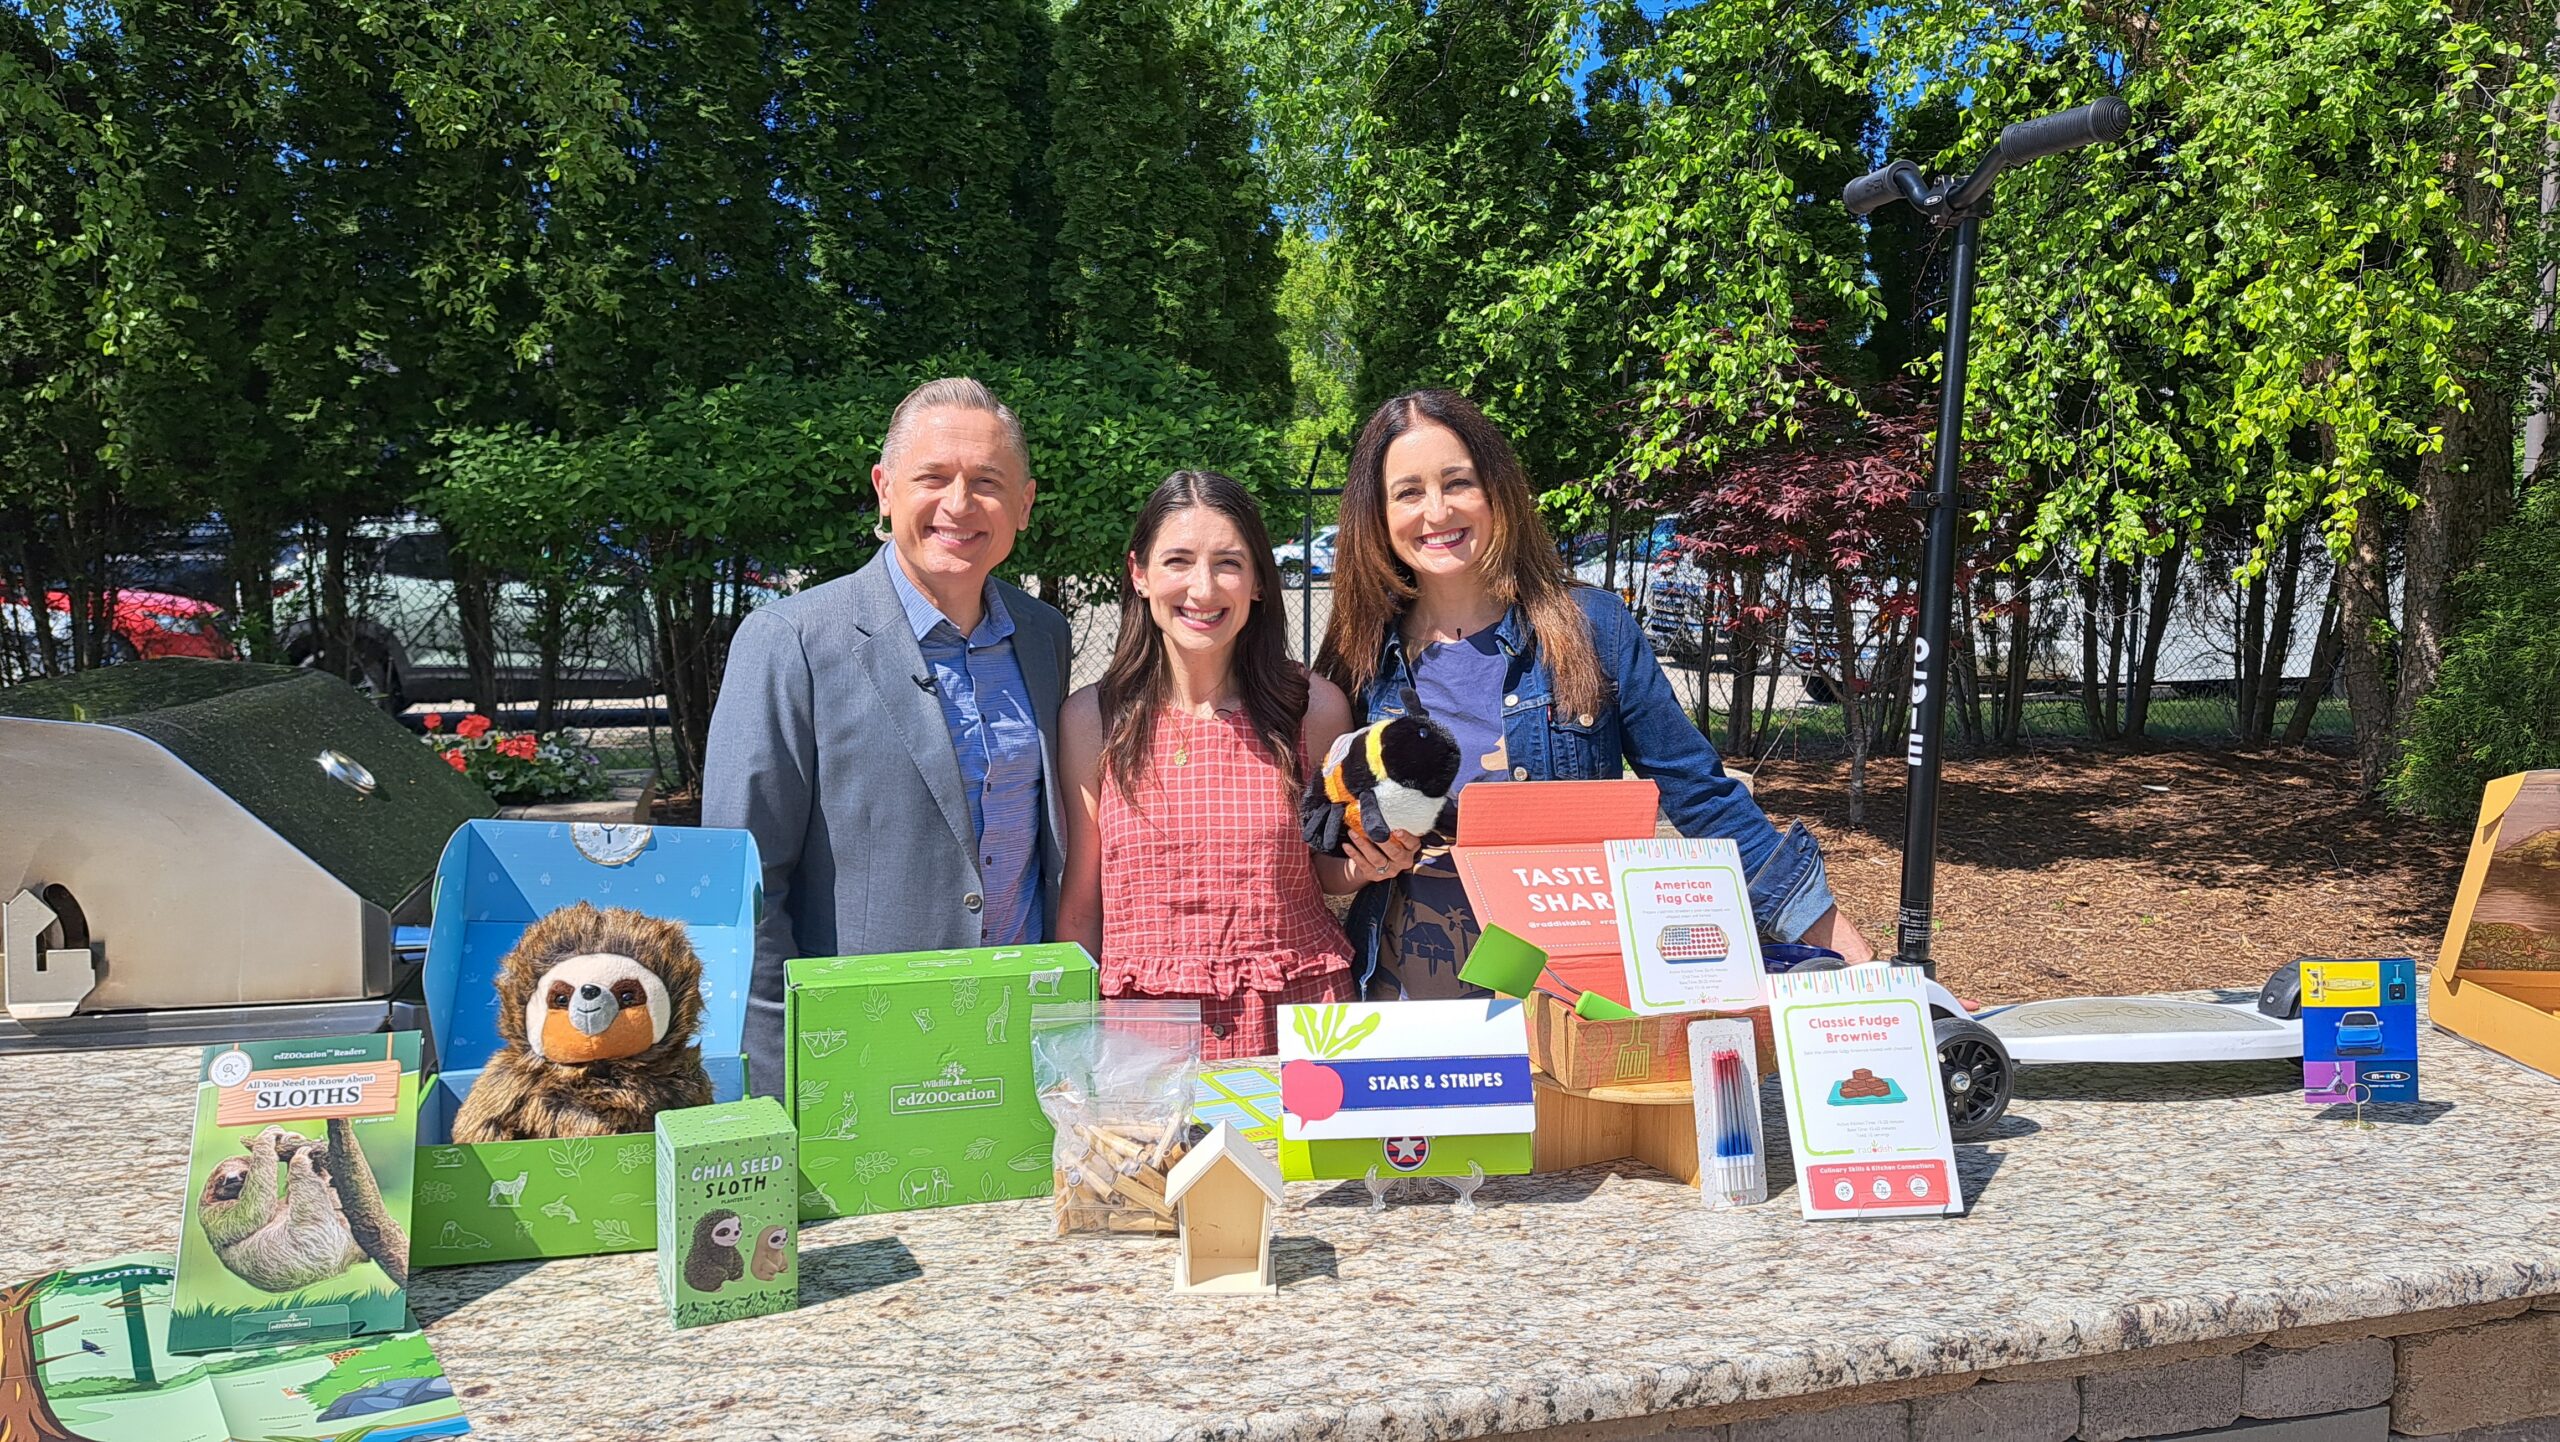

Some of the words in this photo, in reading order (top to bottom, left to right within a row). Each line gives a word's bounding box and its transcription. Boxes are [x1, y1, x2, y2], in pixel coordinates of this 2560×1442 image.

[1512, 866, 1604, 887] TASTE
[1654, 880, 1712, 890] American
[1527, 891, 1615, 913] SHAR
[1656, 894, 1682, 905] Flag
[1685, 893, 1713, 903] Cake
[1528, 919, 1591, 929] @raddishkids
[1809, 1017, 1856, 1029] Classic
[1859, 1015, 1900, 1028] Fudge
[1826, 1030, 1888, 1043] Brownies
[334, 1048, 366, 1057] Readers
[247, 1081, 260, 1089] All
[262, 1080, 280, 1088] You
[282, 1079, 305, 1087] Need
[319, 1077, 345, 1085] Know
[346, 1075, 373, 1083] About
[922, 1079, 952, 1088] Wildlife
[1368, 1075, 1419, 1091] STARS
[1424, 1075, 1435, 1089] &
[1440, 1072, 1503, 1088] STRIPES
[257, 1086, 360, 1109] SLOTHS
[897, 1088, 996, 1106] edZOOcation
[691, 1162, 734, 1181] CHIA
[741, 1155, 783, 1175] SEED
[705, 1176, 766, 1198] SLOTH
[78, 1268, 151, 1284] SLOTH
